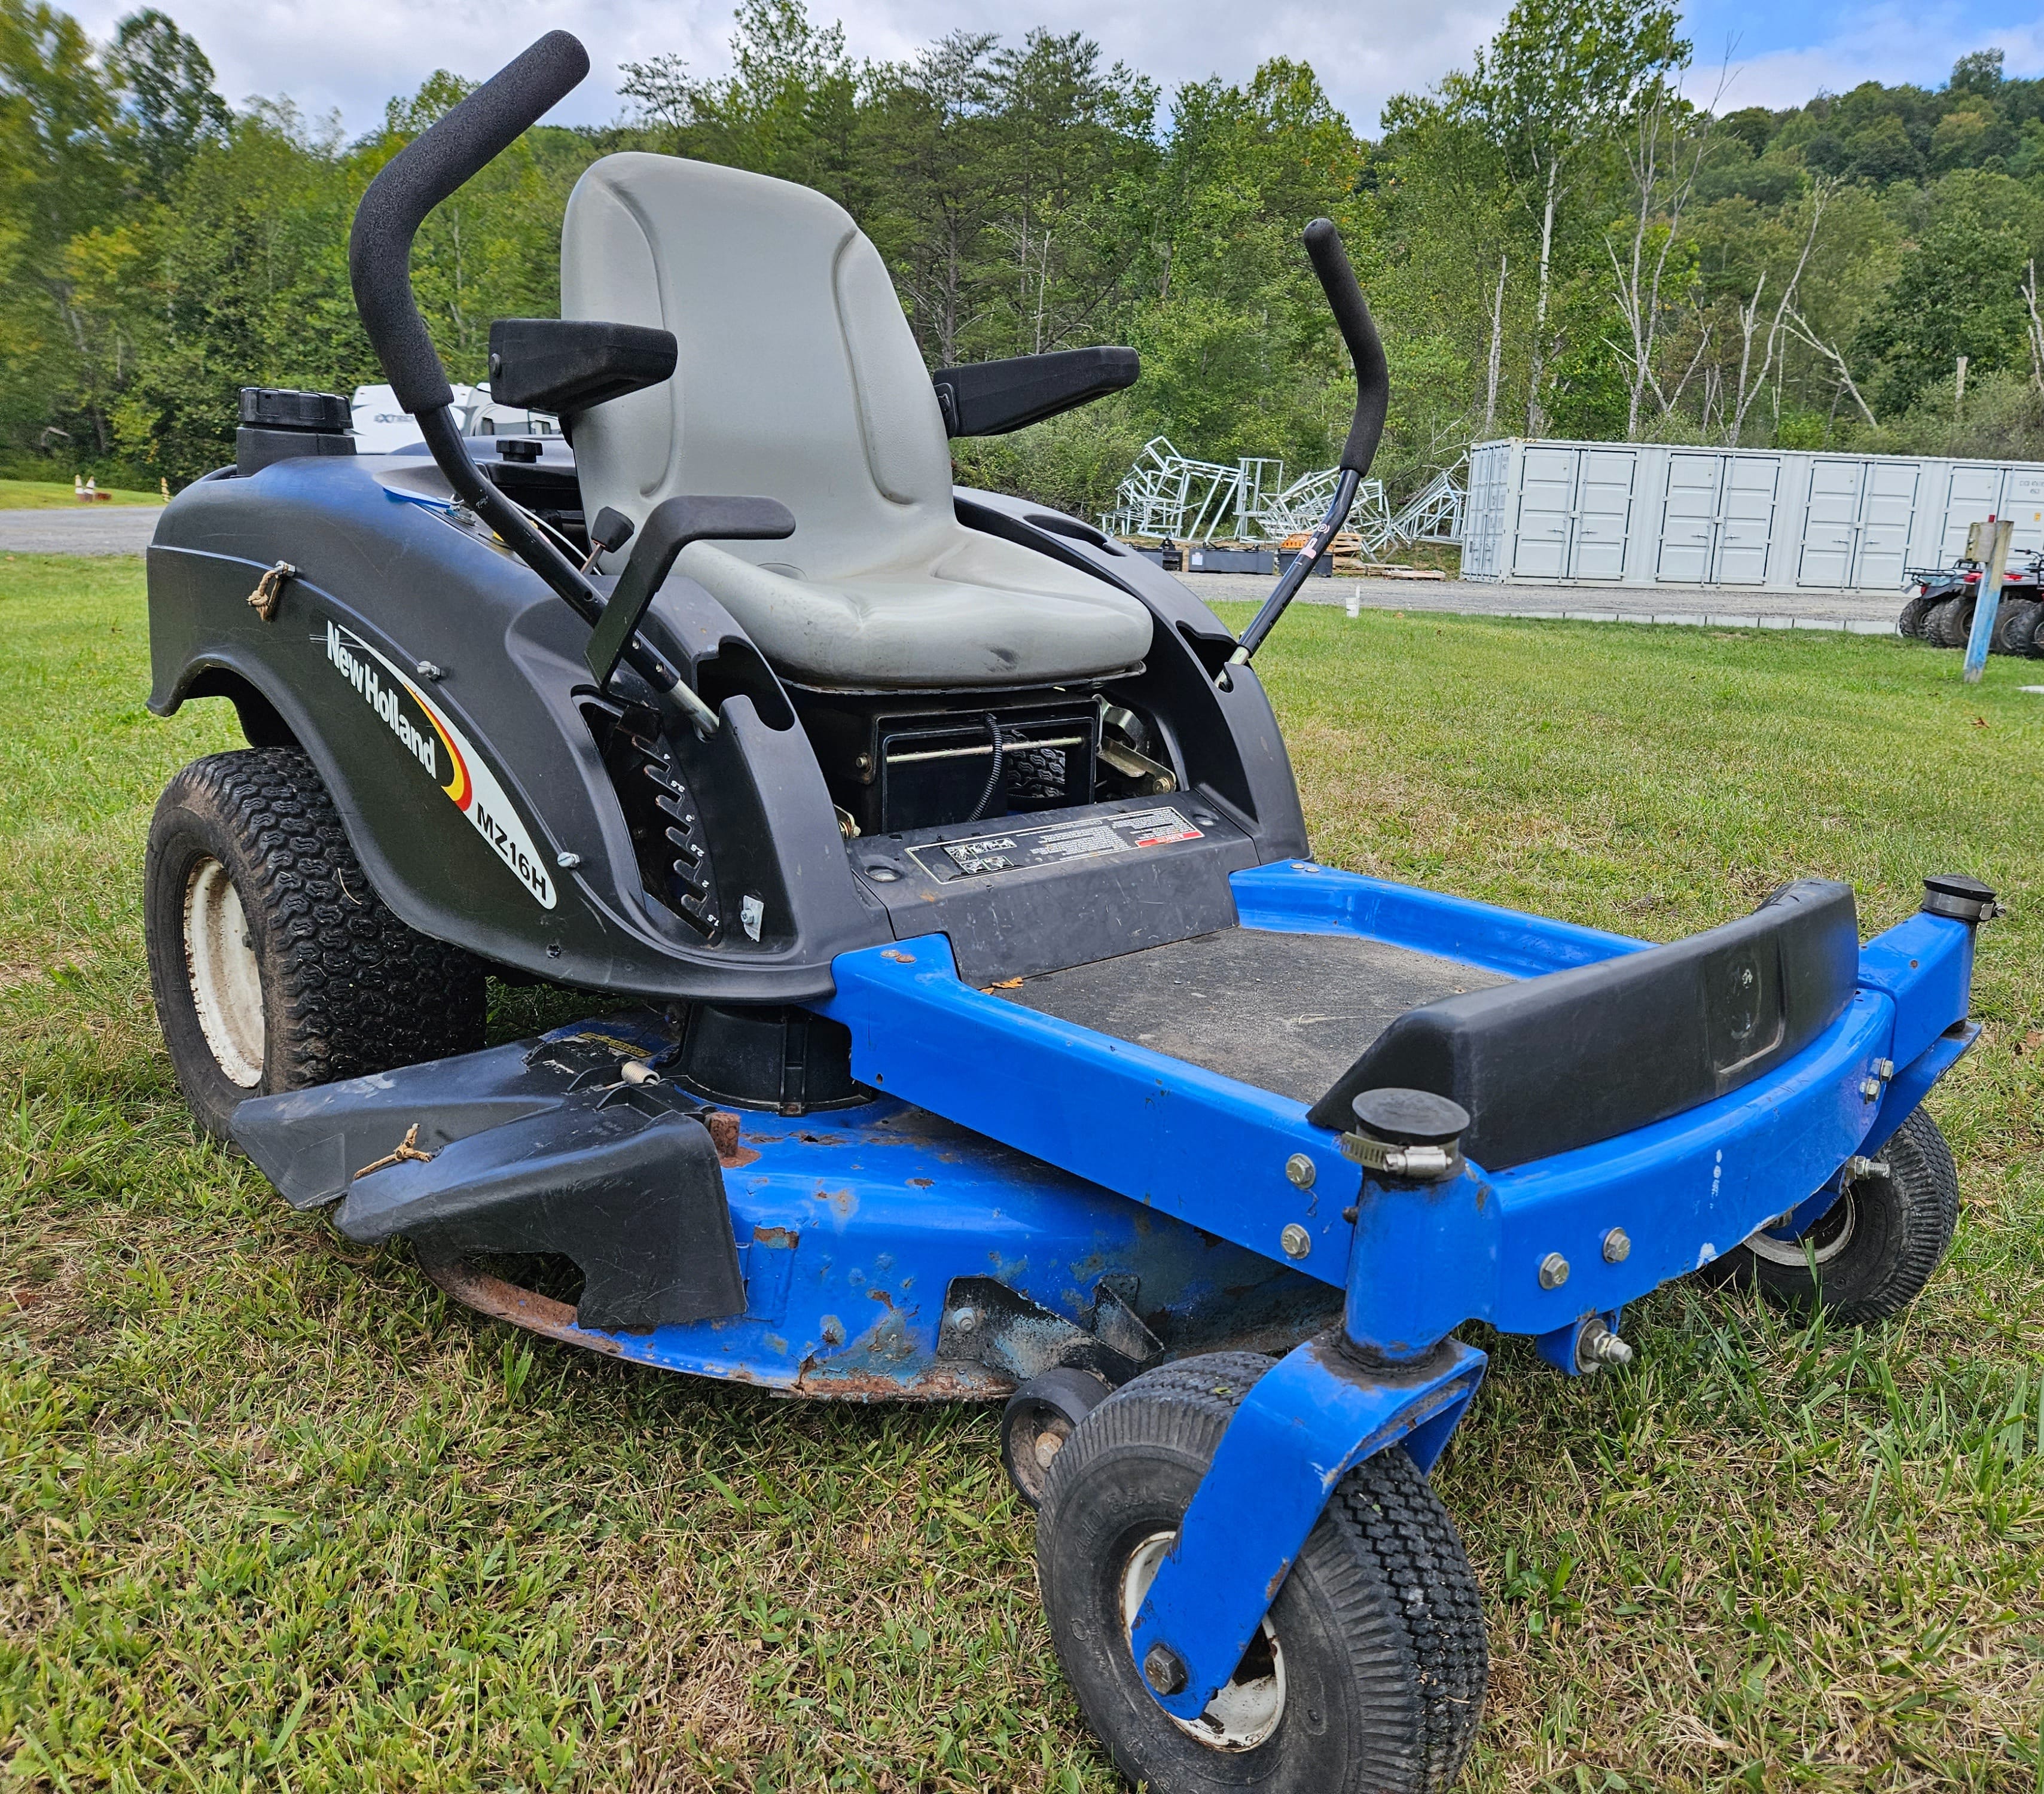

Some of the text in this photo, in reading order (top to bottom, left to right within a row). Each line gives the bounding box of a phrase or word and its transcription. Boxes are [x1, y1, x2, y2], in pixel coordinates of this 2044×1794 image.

[327, 620, 437, 780] New Holland
[670, 780, 685, 792] 3.5
[477, 802, 547, 902] MZ16H
[690, 844, 704, 857] 2.5
[707, 914, 719, 927] 1.5
